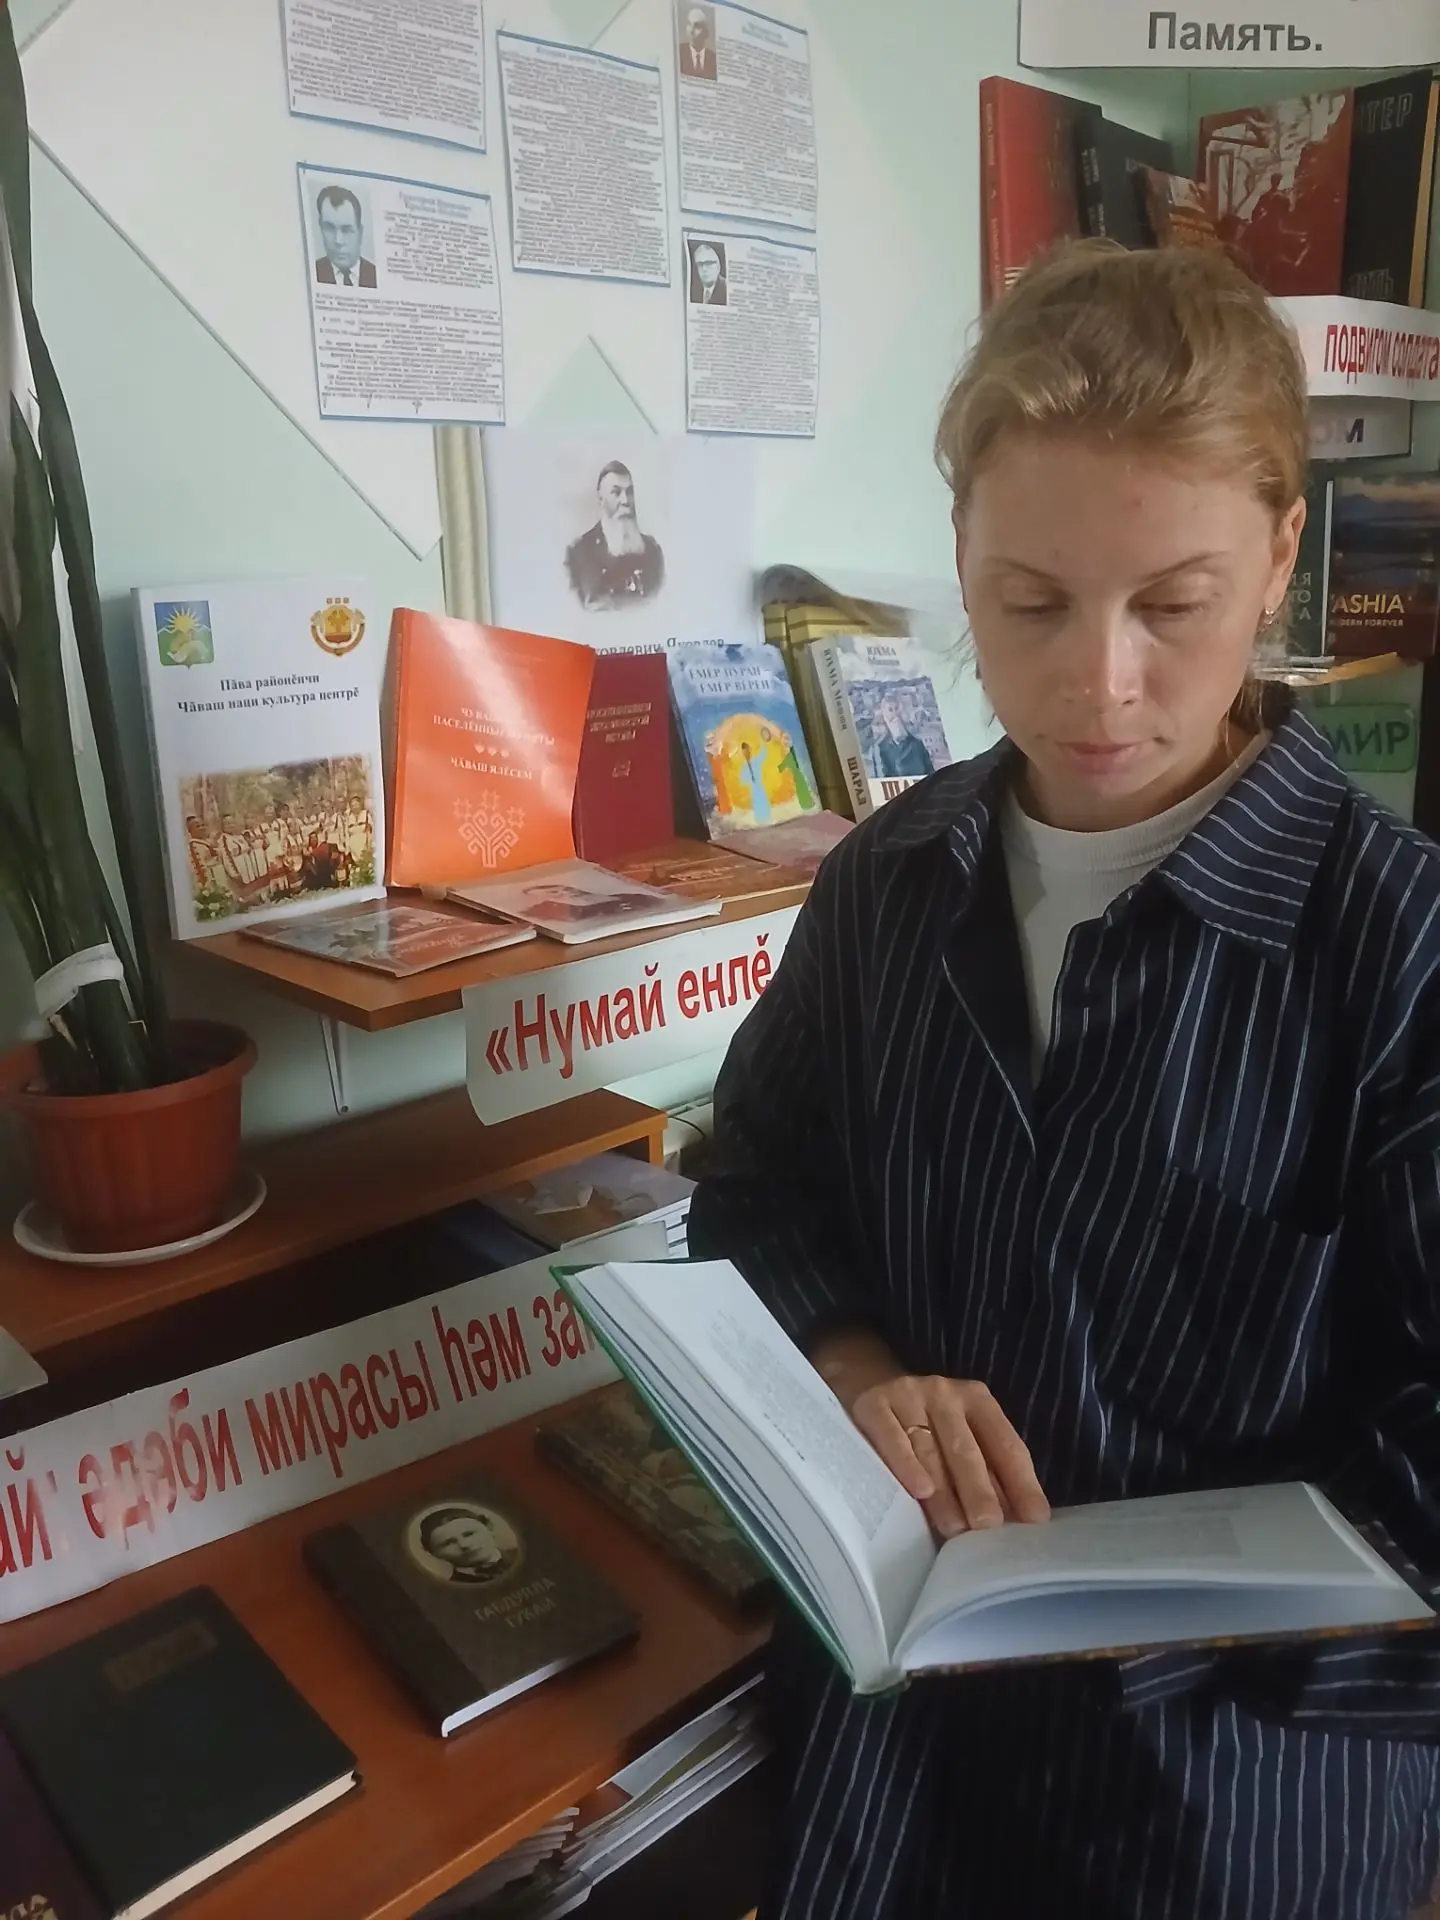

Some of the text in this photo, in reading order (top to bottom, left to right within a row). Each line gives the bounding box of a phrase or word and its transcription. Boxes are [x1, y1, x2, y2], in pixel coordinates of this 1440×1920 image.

[1148, 11, 1323, 52] Память.
[1331, 592, 1406, 614] ASHIA
[261, 691, 317, 710] культура
[485, 962, 667, 1080] «Нумай
[248, 1338, 441, 1478] мирасы
[431, 1305, 532, 1403] һәм
[532, 1287, 597, 1368] за
